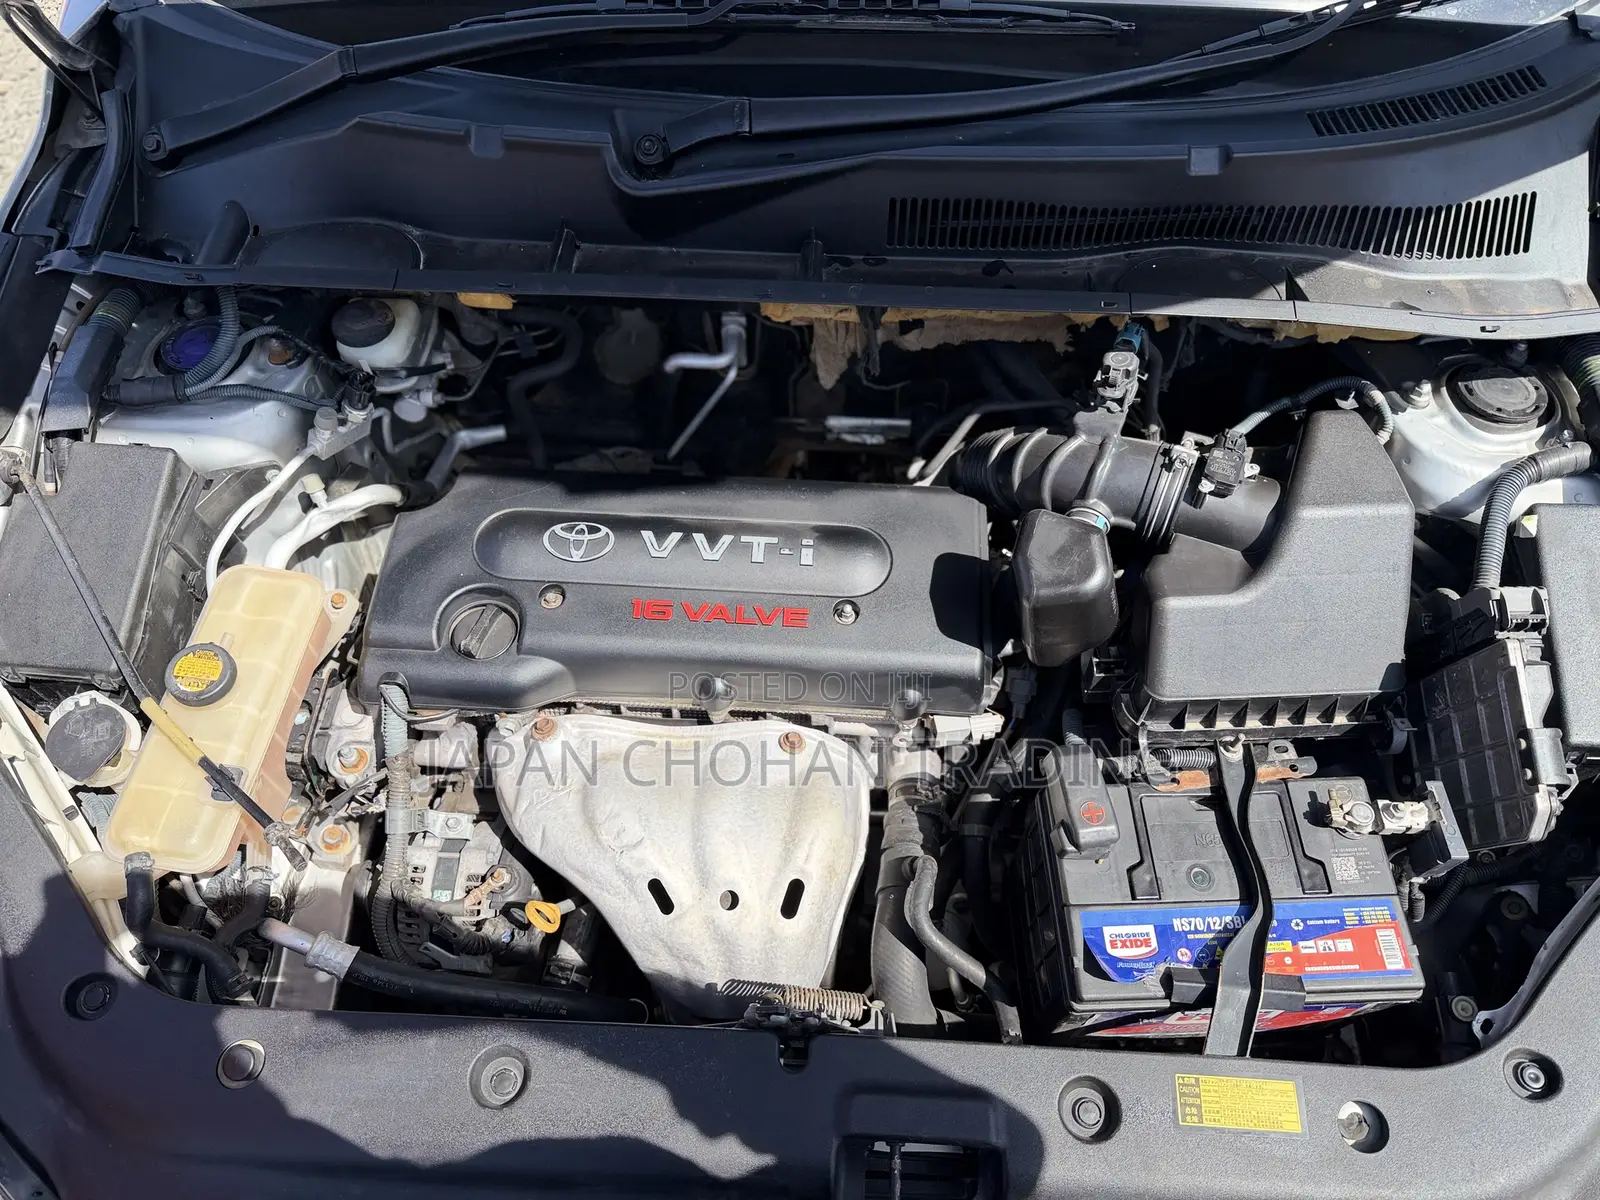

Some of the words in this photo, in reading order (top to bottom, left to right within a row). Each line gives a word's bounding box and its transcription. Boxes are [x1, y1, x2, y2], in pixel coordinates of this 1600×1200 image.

[640, 529, 815, 566] VVT-i
[631, 598, 674, 621] 16
[681, 601, 810, 628] VALVE
[1109, 931, 1151, 939] CHLORIDE
[1109, 938, 1153, 950] EXIDE
